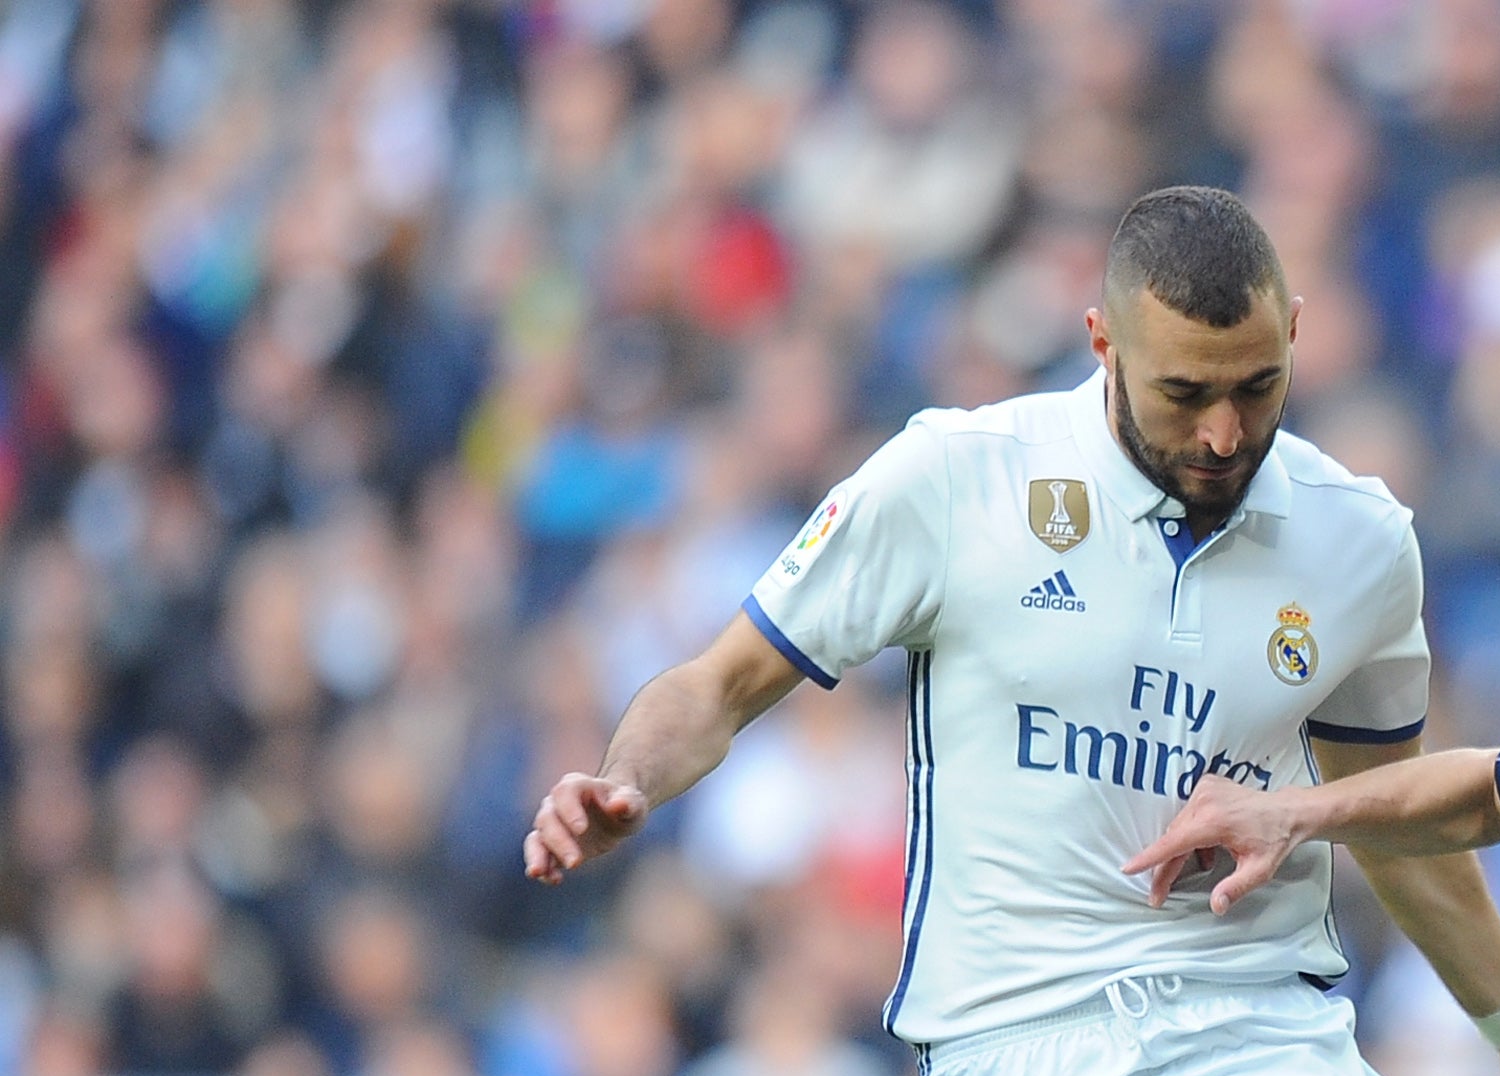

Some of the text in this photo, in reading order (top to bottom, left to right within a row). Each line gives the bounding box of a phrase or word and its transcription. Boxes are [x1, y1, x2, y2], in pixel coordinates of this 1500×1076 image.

[1045, 522, 1075, 535] FIFA
[1020, 594, 1086, 613] adidas
[1131, 664, 1216, 732] Fly
